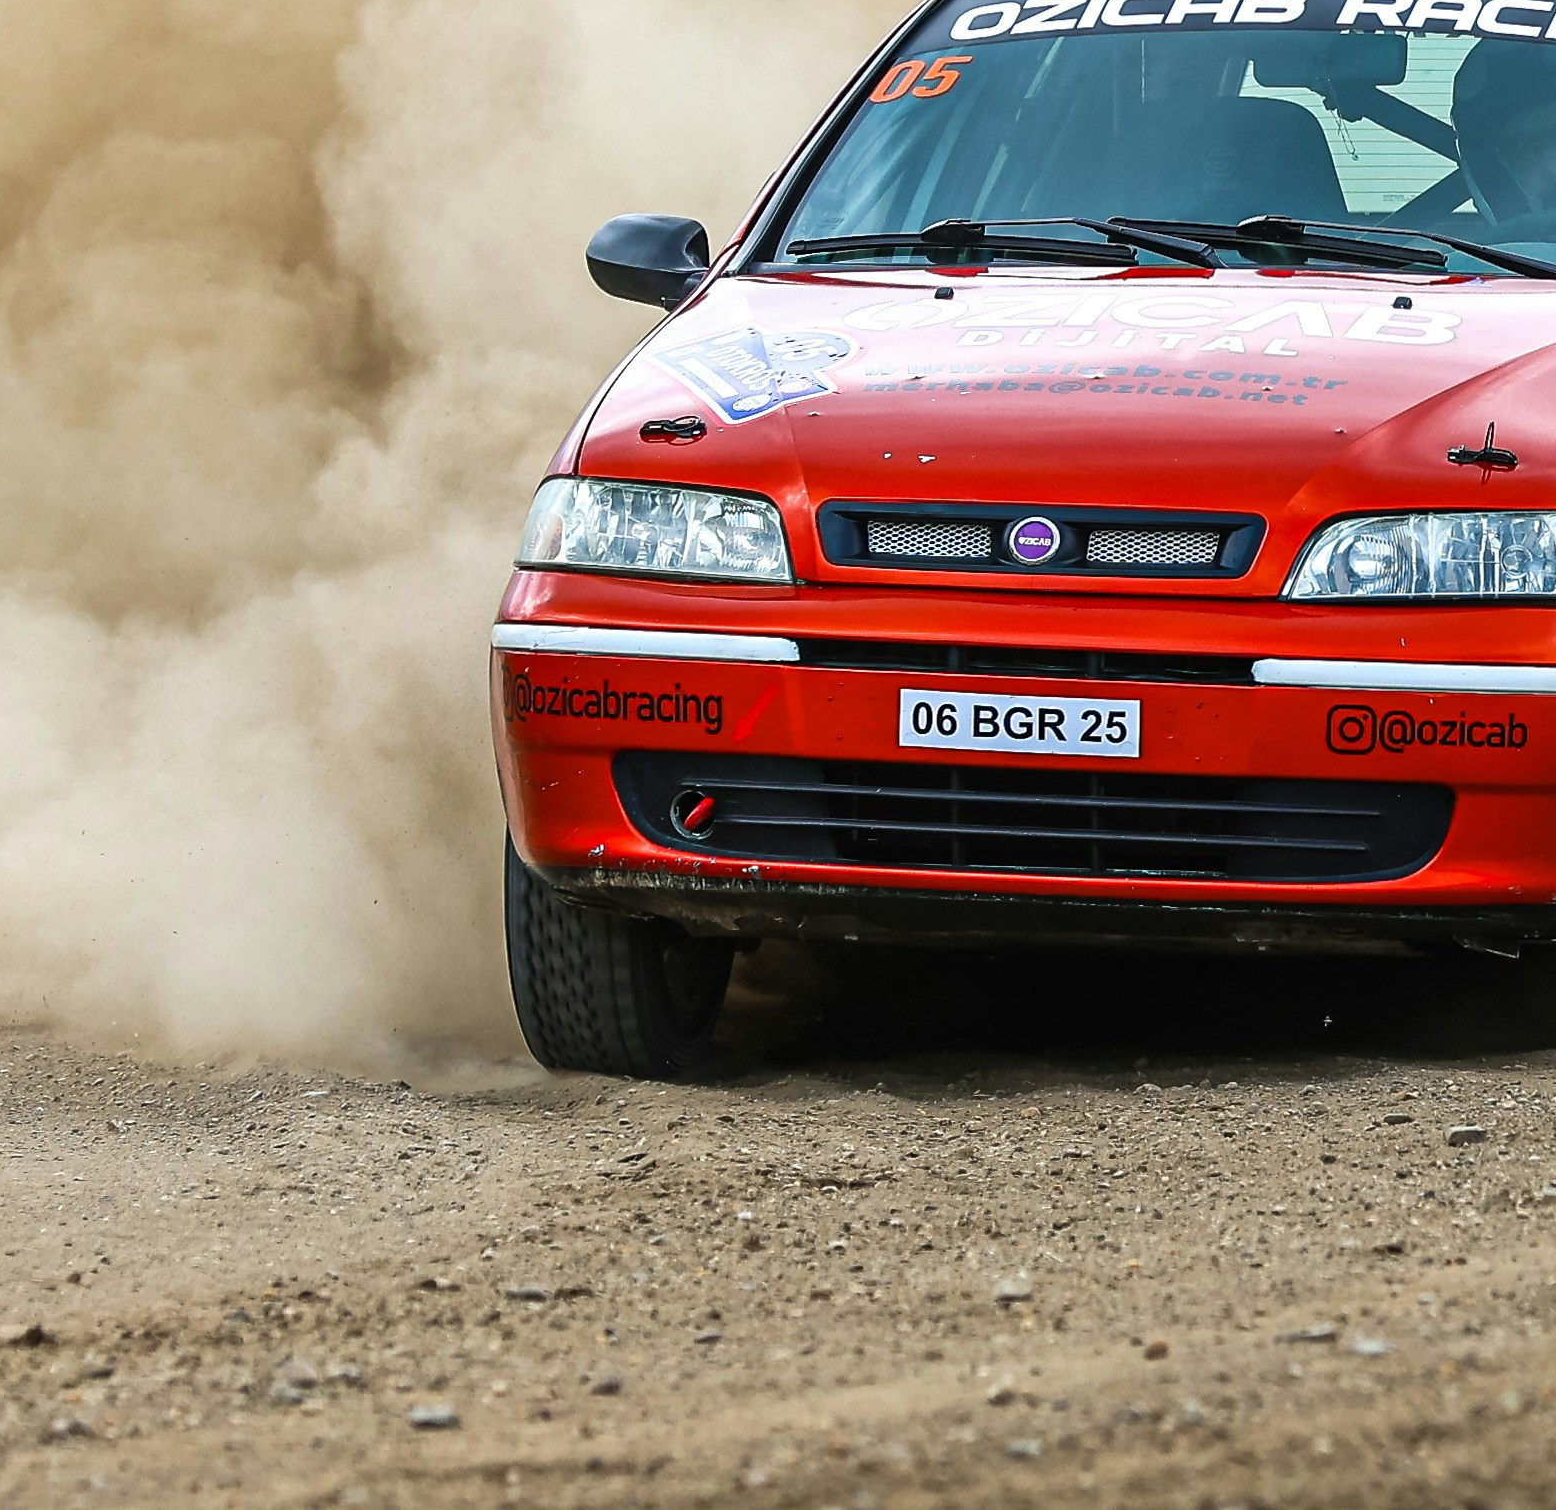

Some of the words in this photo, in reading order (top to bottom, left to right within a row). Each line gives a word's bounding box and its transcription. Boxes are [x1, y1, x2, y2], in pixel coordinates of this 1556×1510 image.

[869, 56, 973, 104] 05
[842, 293, 1464, 345] OZICAB
[863, 379, 1309, 406] merhaba@ozicab.net
[864, 362, 1349, 390] www.ozicab.com.tr
[514, 672, 724, 735] @ozicabracing
[912, 701, 958, 737] 06
[971, 703, 1067, 742] BGR
[1080, 709, 1128, 745] 25
[1378, 709, 1528, 754] @ozicab
